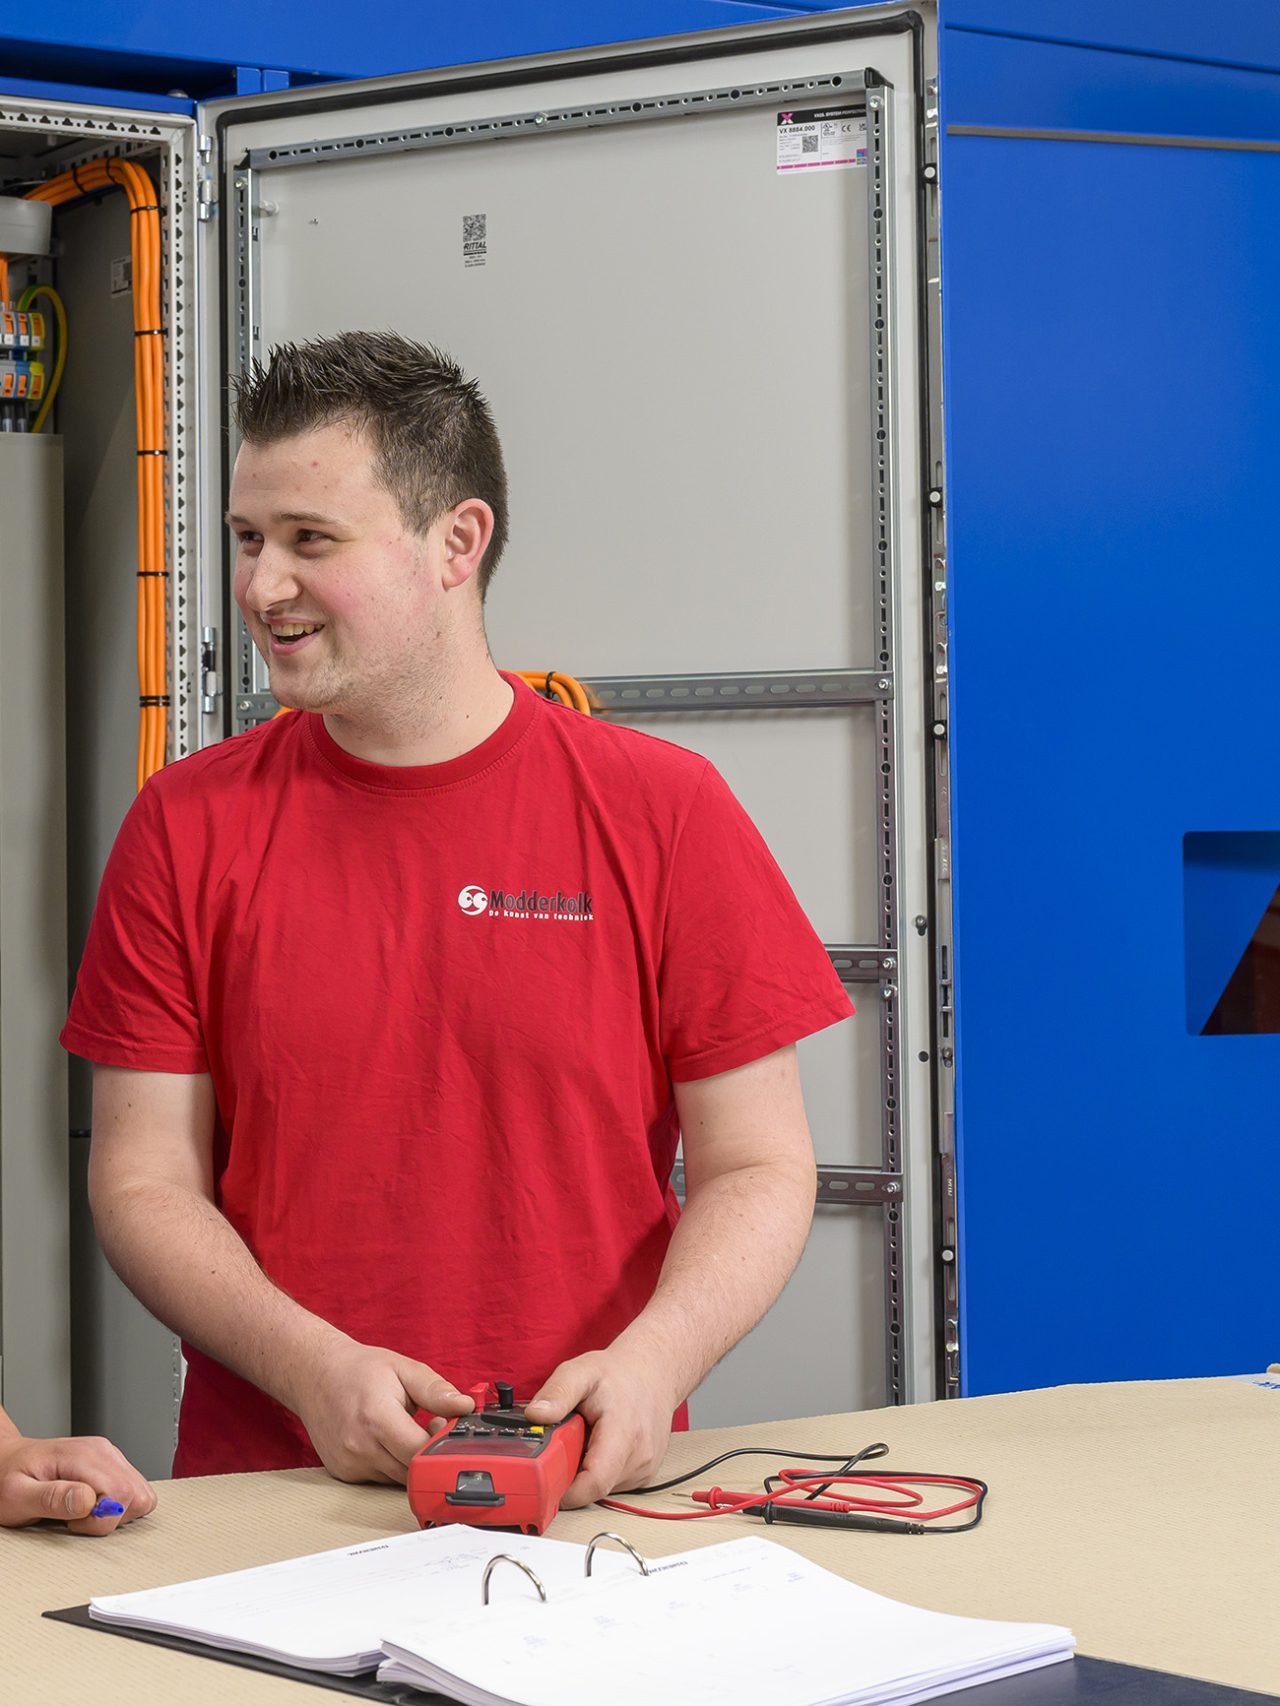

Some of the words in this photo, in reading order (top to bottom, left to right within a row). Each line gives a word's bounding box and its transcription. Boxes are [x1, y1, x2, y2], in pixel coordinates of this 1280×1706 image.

[489, 890, 593, 913] Modderkolk
[504, 910, 530, 919] kunst
[553, 913, 594, 921] techniek
